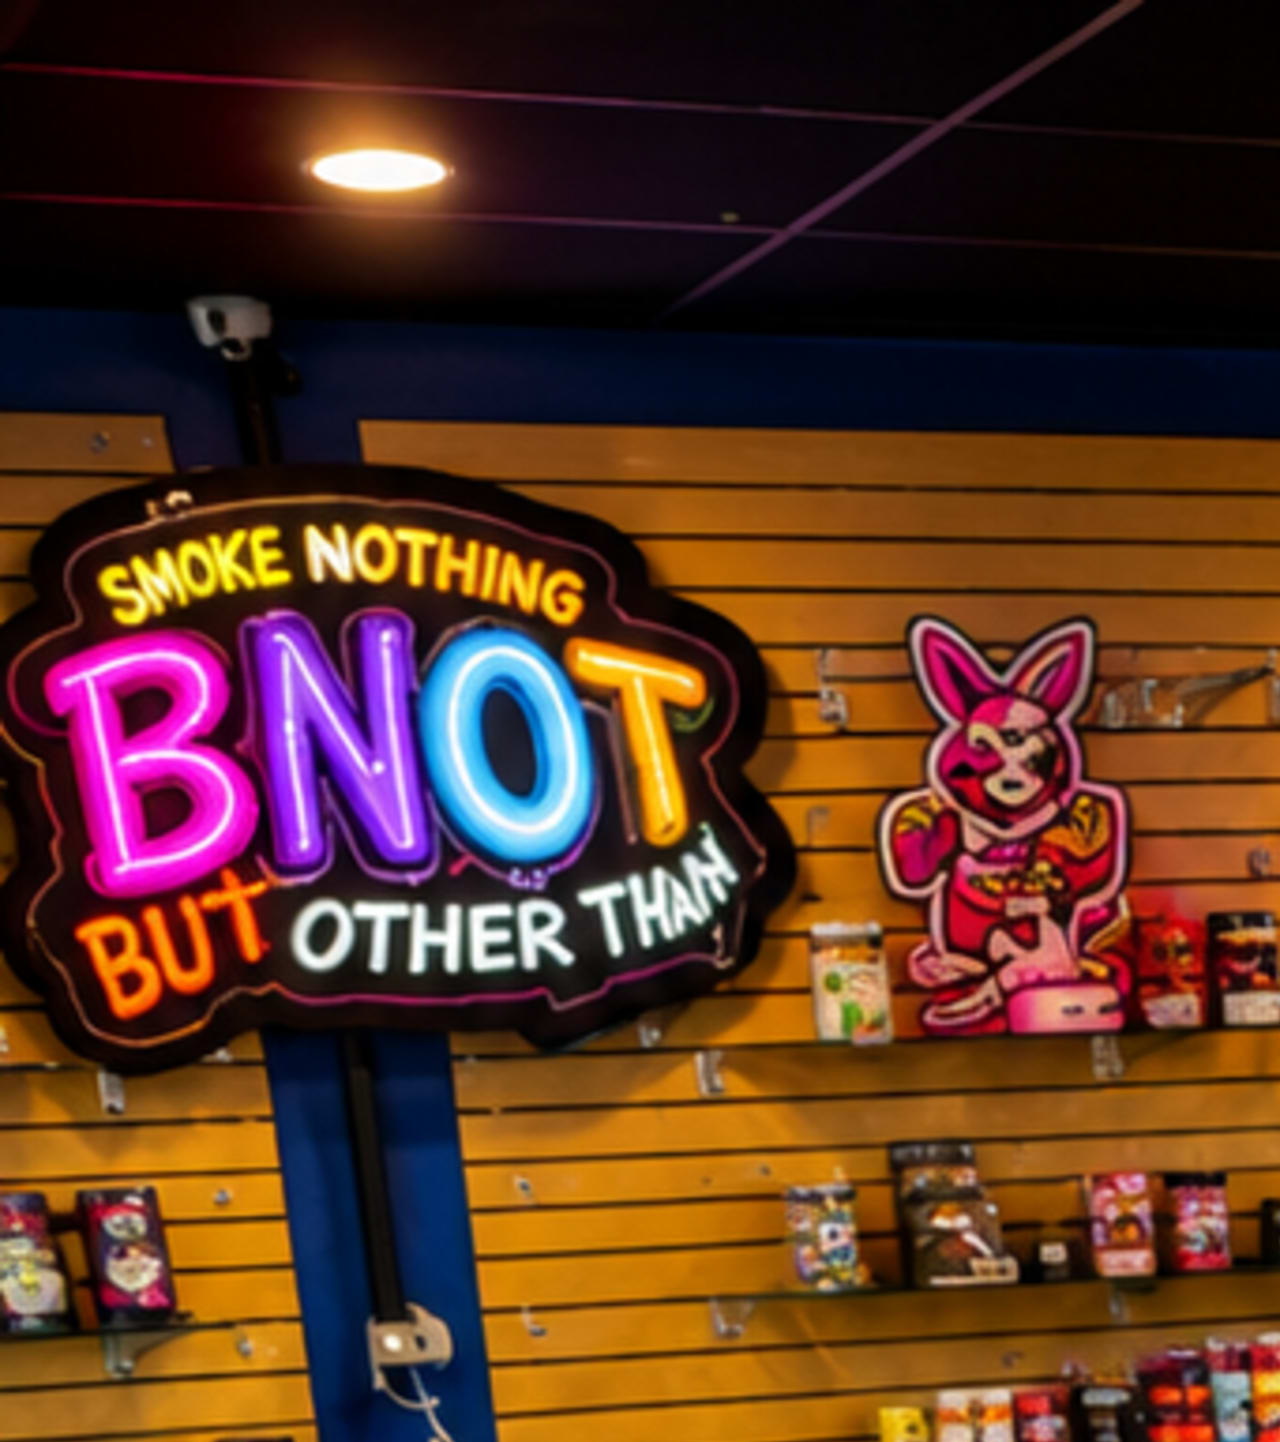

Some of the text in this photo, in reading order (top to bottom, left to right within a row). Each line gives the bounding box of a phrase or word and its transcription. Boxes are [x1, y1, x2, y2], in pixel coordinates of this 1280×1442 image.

[99, 523, 586, 625] SMOKE NOTHING
[46, 612, 706, 895] BNOT
[76, 824, 740, 1020] BUT OTHER THAN
